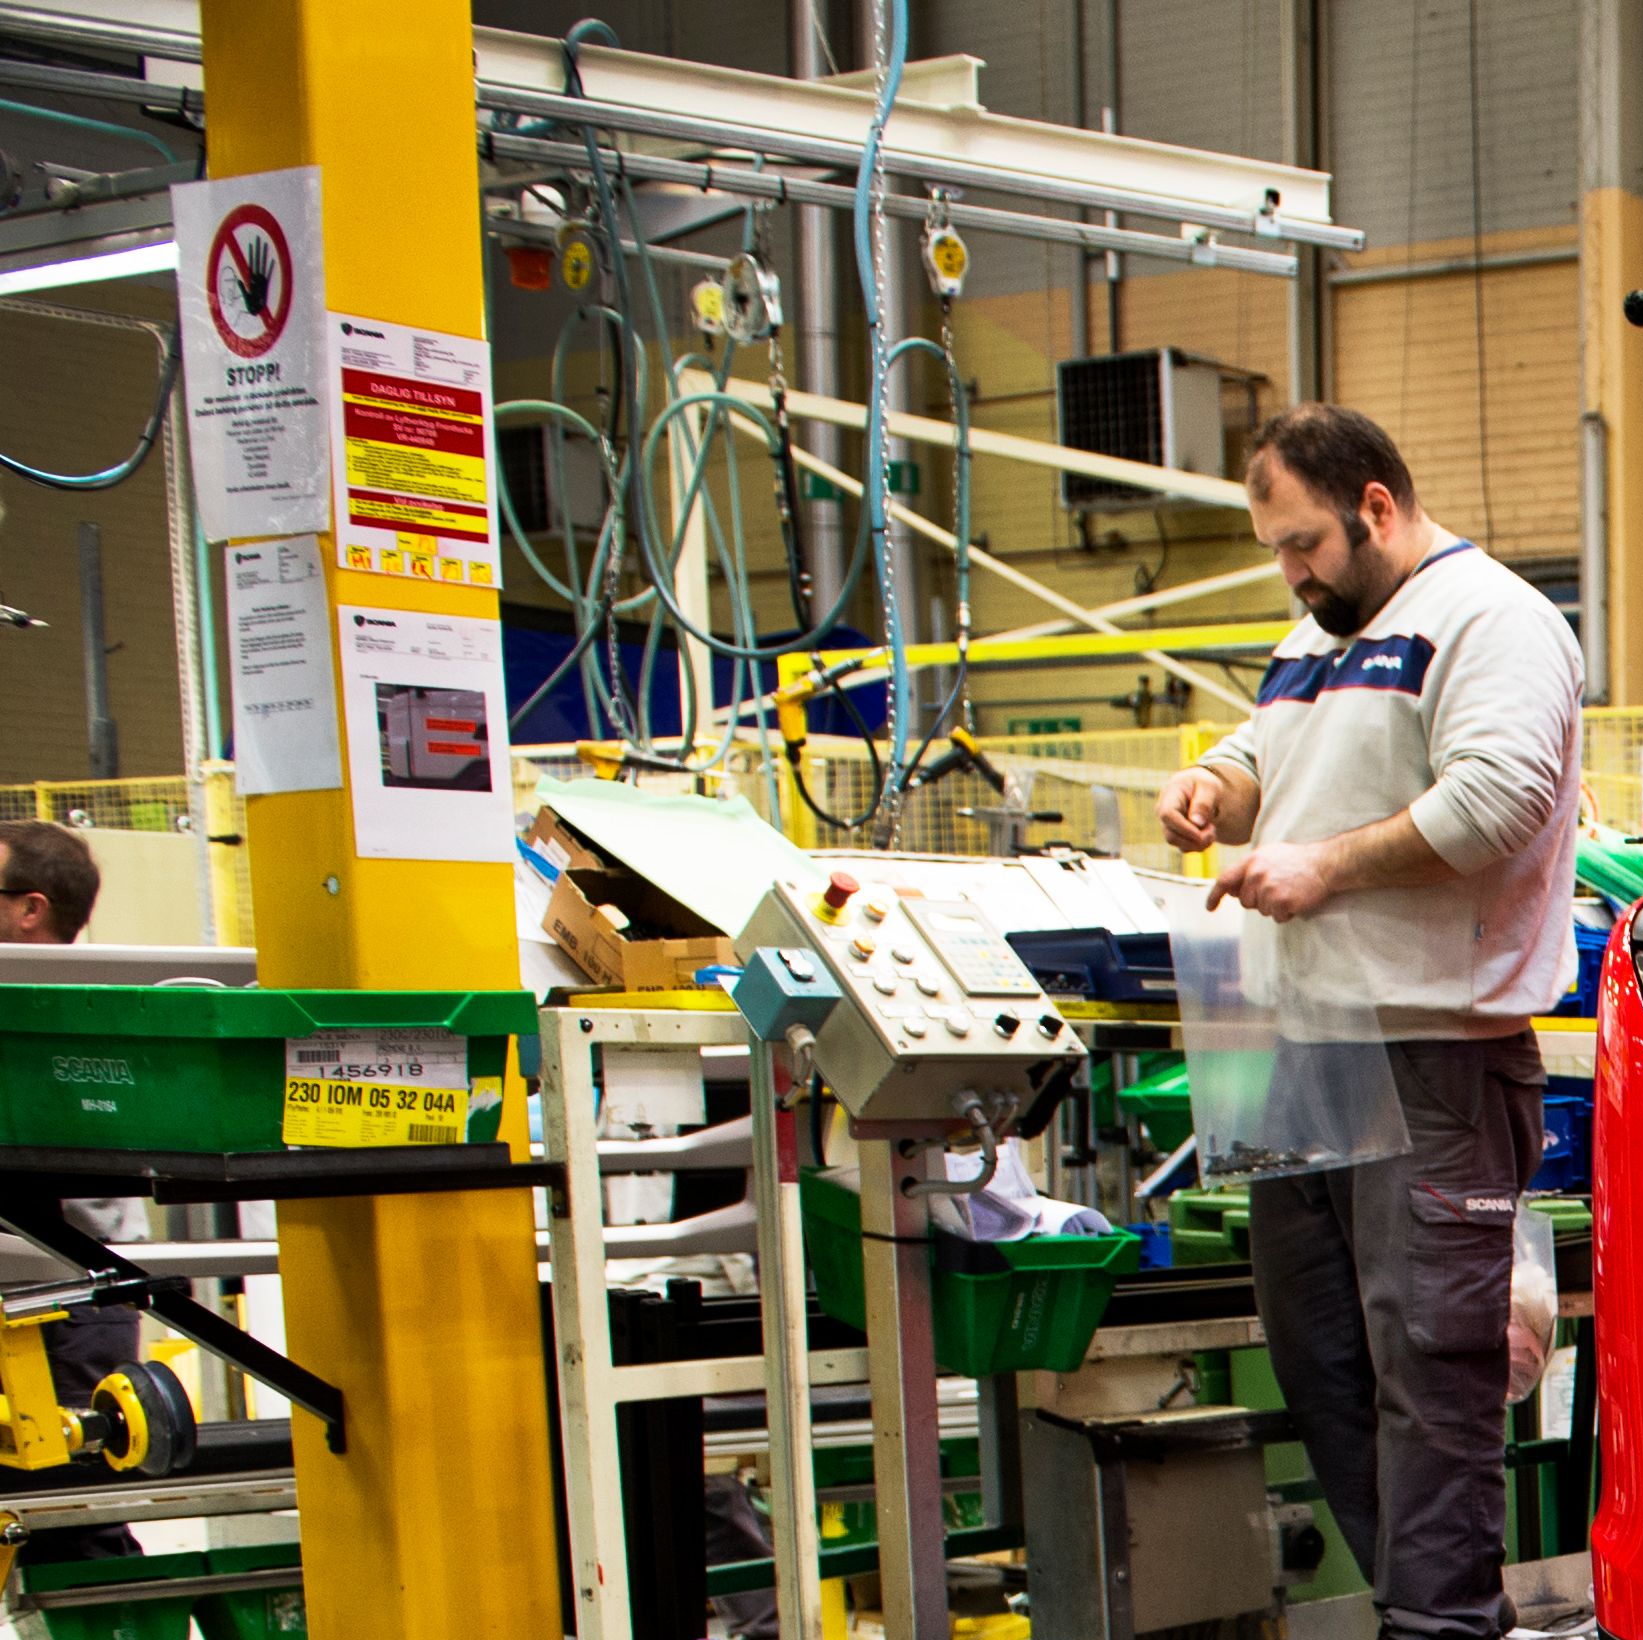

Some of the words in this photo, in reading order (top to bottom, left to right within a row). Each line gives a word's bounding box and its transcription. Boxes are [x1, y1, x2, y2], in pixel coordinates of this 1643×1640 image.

[226, 362, 281, 386] STOPP!
[370, 382, 412, 399] DAGLIG
[413, 390, 456, 407] TILLSYN
[51, 1055, 135, 1085] SCANIA
[318, 1063, 424, 1080] 1456918
[288, 1082, 320, 1103] 230
[369, 1087, 390, 1108] 05
[396, 1090, 418, 1111] 32
[424, 1092, 455, 1113] 04A
[1465, 1197, 1514, 1212] SCANIA
